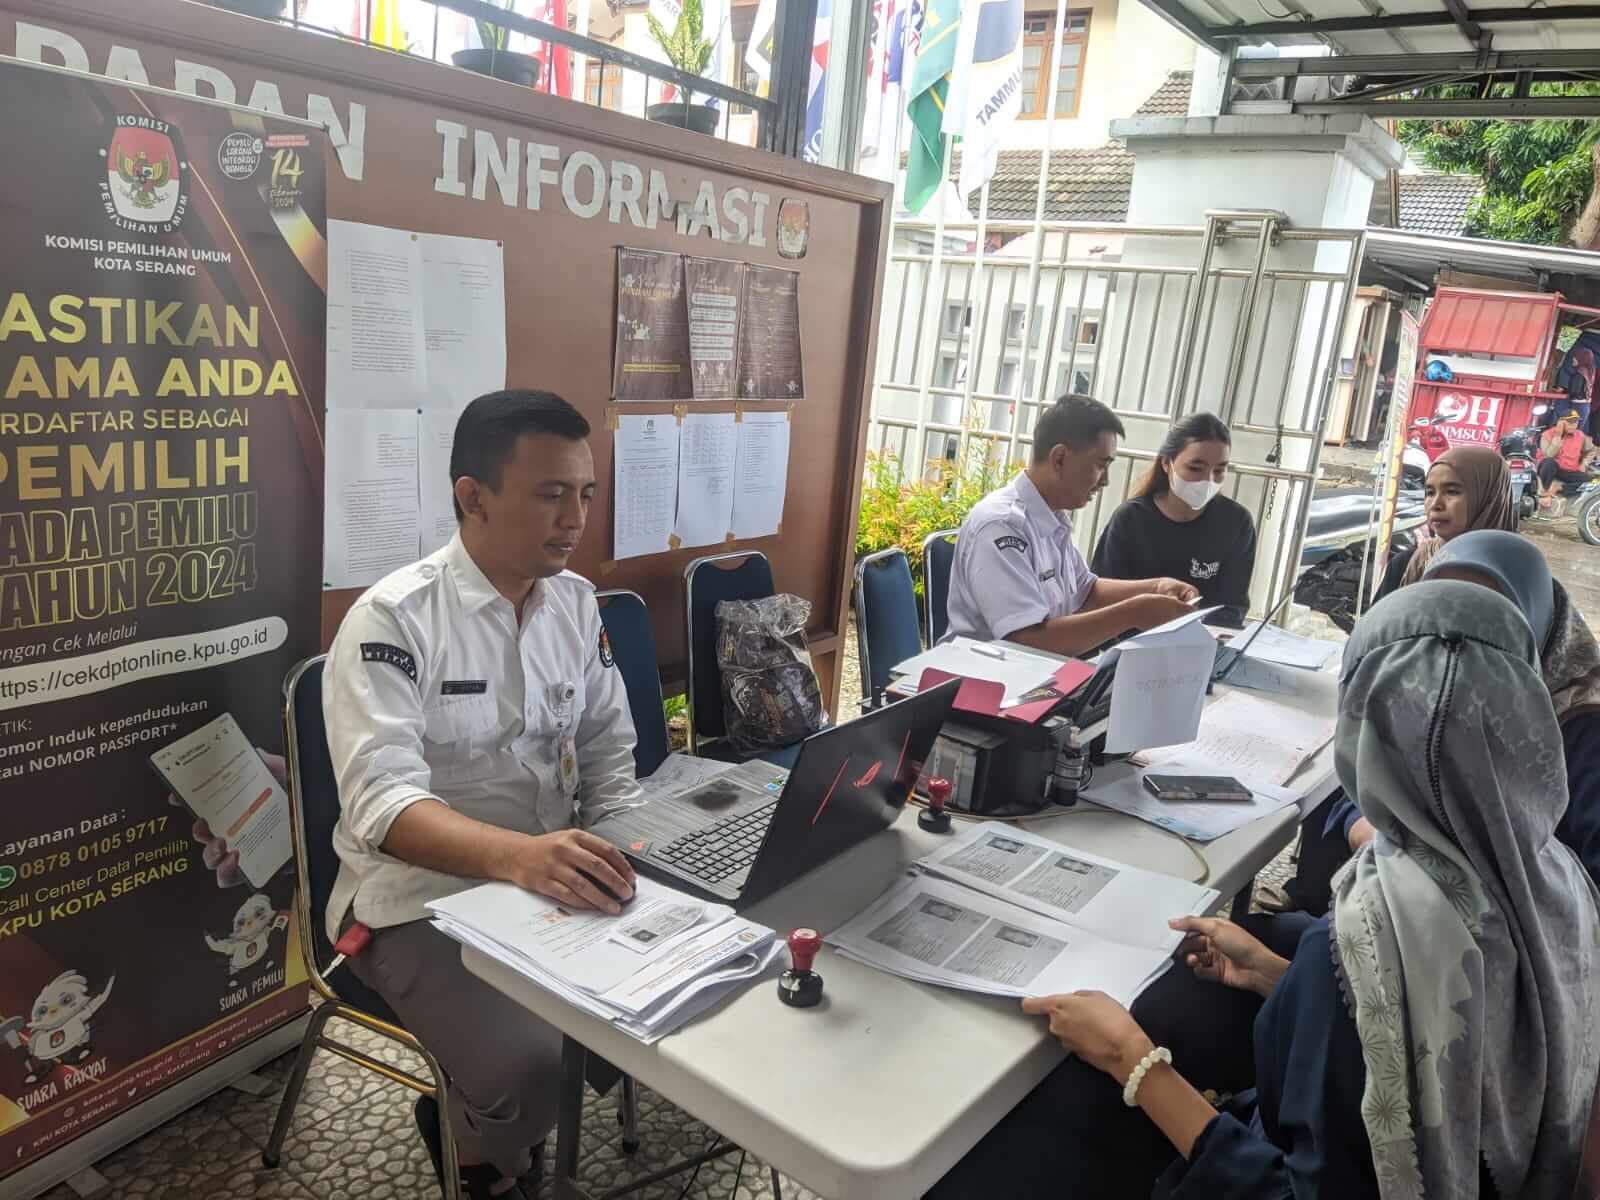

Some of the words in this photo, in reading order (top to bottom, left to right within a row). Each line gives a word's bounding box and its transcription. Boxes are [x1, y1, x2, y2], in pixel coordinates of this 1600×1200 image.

[117, 115, 169, 133] KOMISI
[271, 148, 304, 189] 14
[434, 119, 769, 248] INFORMASI
[99, 182, 157, 233] PEMILIHAN
[164, 194, 188, 232] UMUM
[45, 234, 103, 252] KOMISI
[107, 240, 188, 260] PEMILIHAN
[191, 249, 231, 264] UMUM
[94, 256, 132, 271] KOTA
[135, 260, 196, 276] SERANG
[0, 292, 259, 348] ASTIKAN
[4, 355, 140, 399] AMA
[156, 357, 299, 397] ANDA
[0, 409, 135, 435] RDAFTAR
[143, 407, 249, 430] SEBAGAI
[0, 436, 249, 500] EMILIH
[108, 491, 258, 556] PEMILU
[0, 557, 137, 630] AHUN
[146, 543, 258, 607] 2024
[0, 642, 46, 663] ngan
[53, 634, 82, 653] Cek
[87, 621, 138, 647] Melalui
[0, 626, 268, 699] ttps://cekdptonline.kpu.go.id
[49, 726, 96, 747] Induk
[100, 699, 208, 735] Kependudukan
[29, 746, 96, 773] NOMOR
[0, 826, 75, 857] ayanan
[80, 811, 118, 834] Data
[19, 851, 71, 879] 0878
[77, 833, 122, 862] 0105
[126, 816, 168, 843] 9717
[0, 892, 29, 915] Call
[35, 875, 93, 903] Center
[97, 860, 131, 882] Data
[134, 839, 189, 867] Pemilih
[0, 910, 43, 938] KPU
[51, 888, 107, 921] KOTA
[111, 858, 189, 898] SERANG
[219, 986, 248, 1012] SUARA
[252, 967, 284, 995] PEMILU
[16, 1080, 58, 1111] SUARA
[63, 1057, 107, 1091] RAKYAT
[54, 1119, 79, 1137] KOTA
